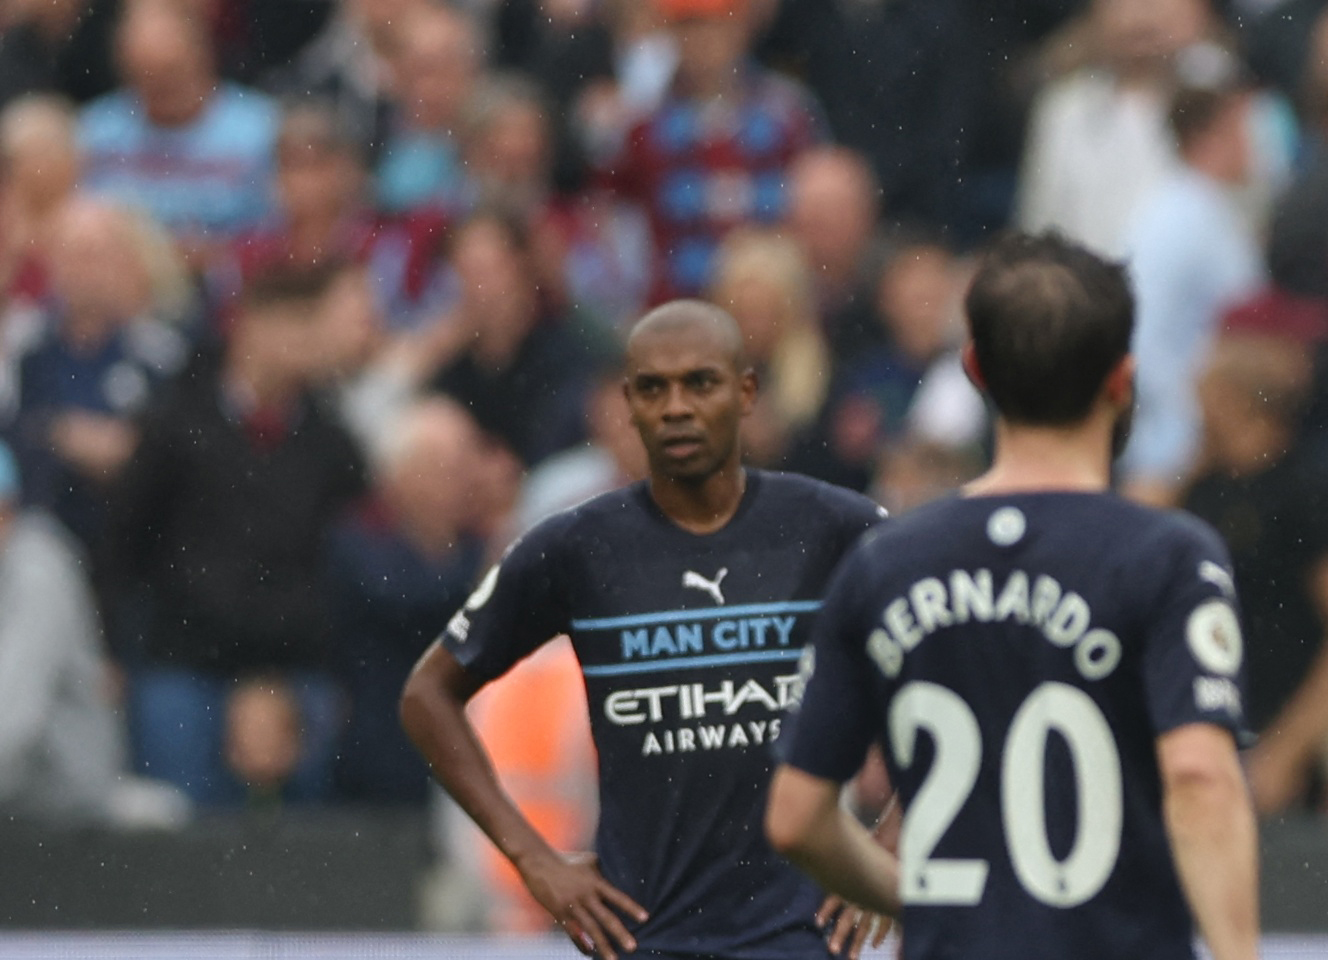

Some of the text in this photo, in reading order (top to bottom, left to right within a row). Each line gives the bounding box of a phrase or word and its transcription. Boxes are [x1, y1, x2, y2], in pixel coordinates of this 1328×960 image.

[620, 615, 797, 660] MAN CITY
[865, 567, 1123, 682] BERNARDO
[640, 719, 782, 757] AIRWAYS
[886, 679, 1125, 910] 20
